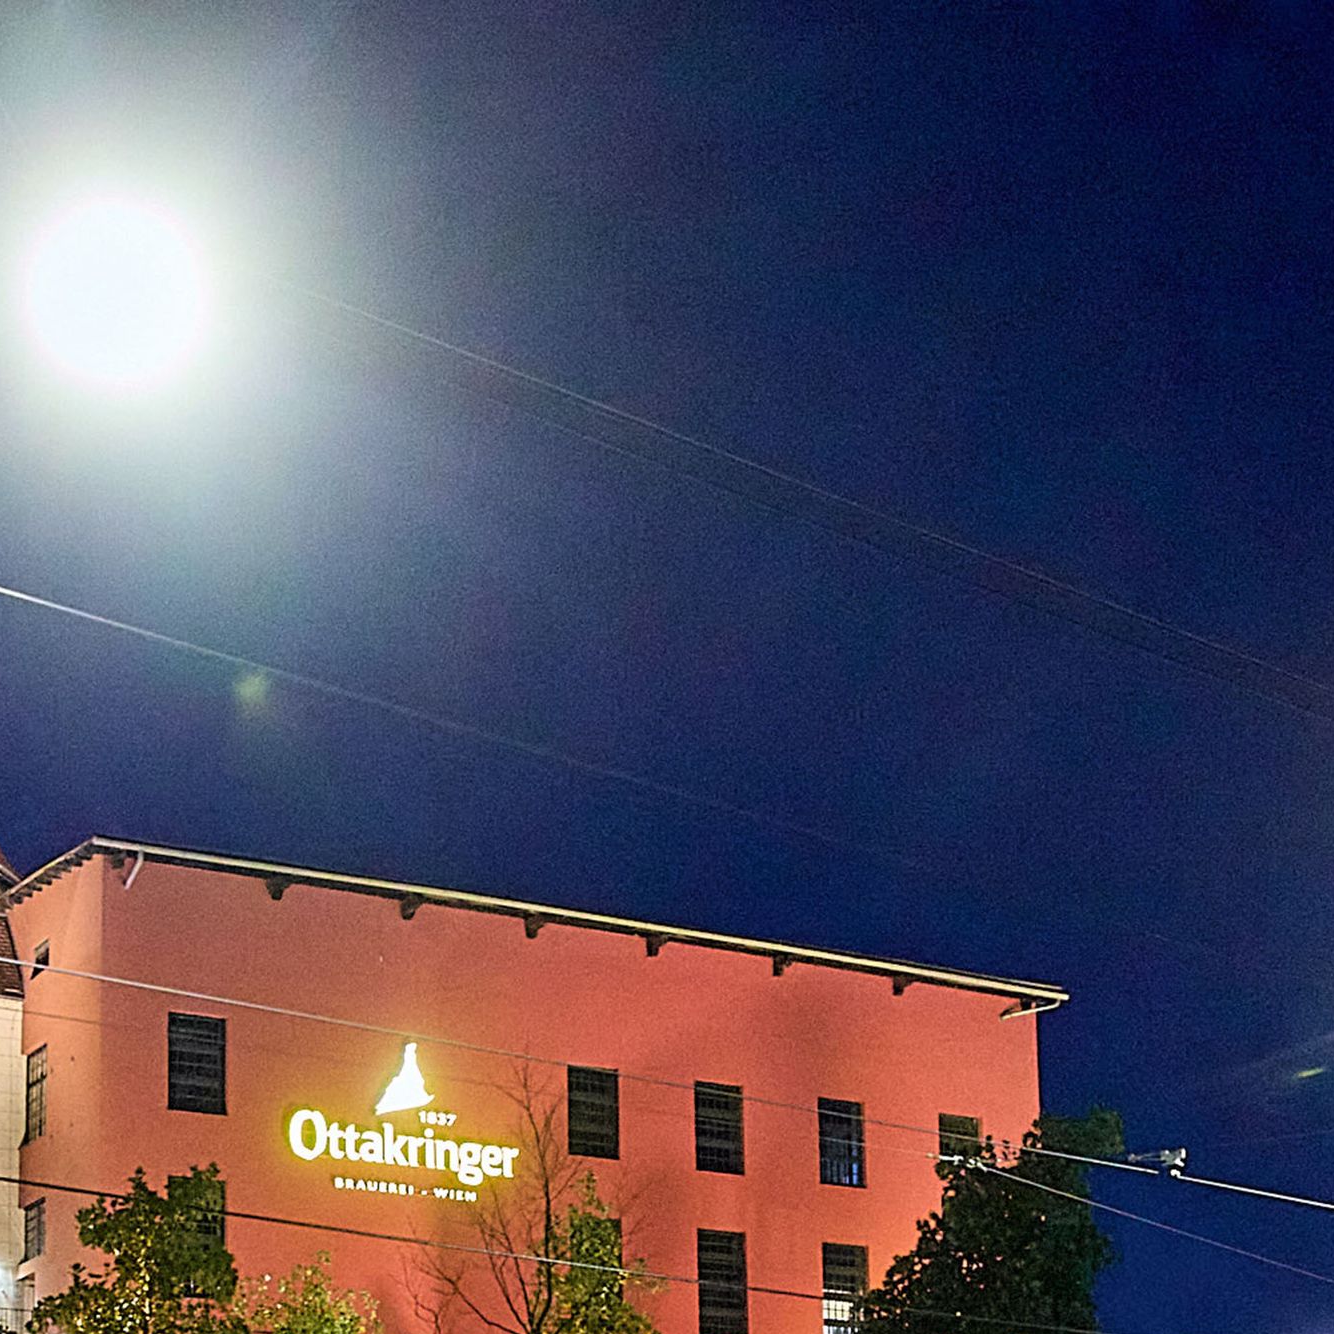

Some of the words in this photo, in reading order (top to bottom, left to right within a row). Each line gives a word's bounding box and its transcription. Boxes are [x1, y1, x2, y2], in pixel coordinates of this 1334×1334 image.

[418, 1110, 457, 1127] 1837
[288, 1109, 519, 1186] Ottakringer
[334, 1177, 415, 1196] BRAUEREI
[433, 1187, 478, 1202] WIEN
